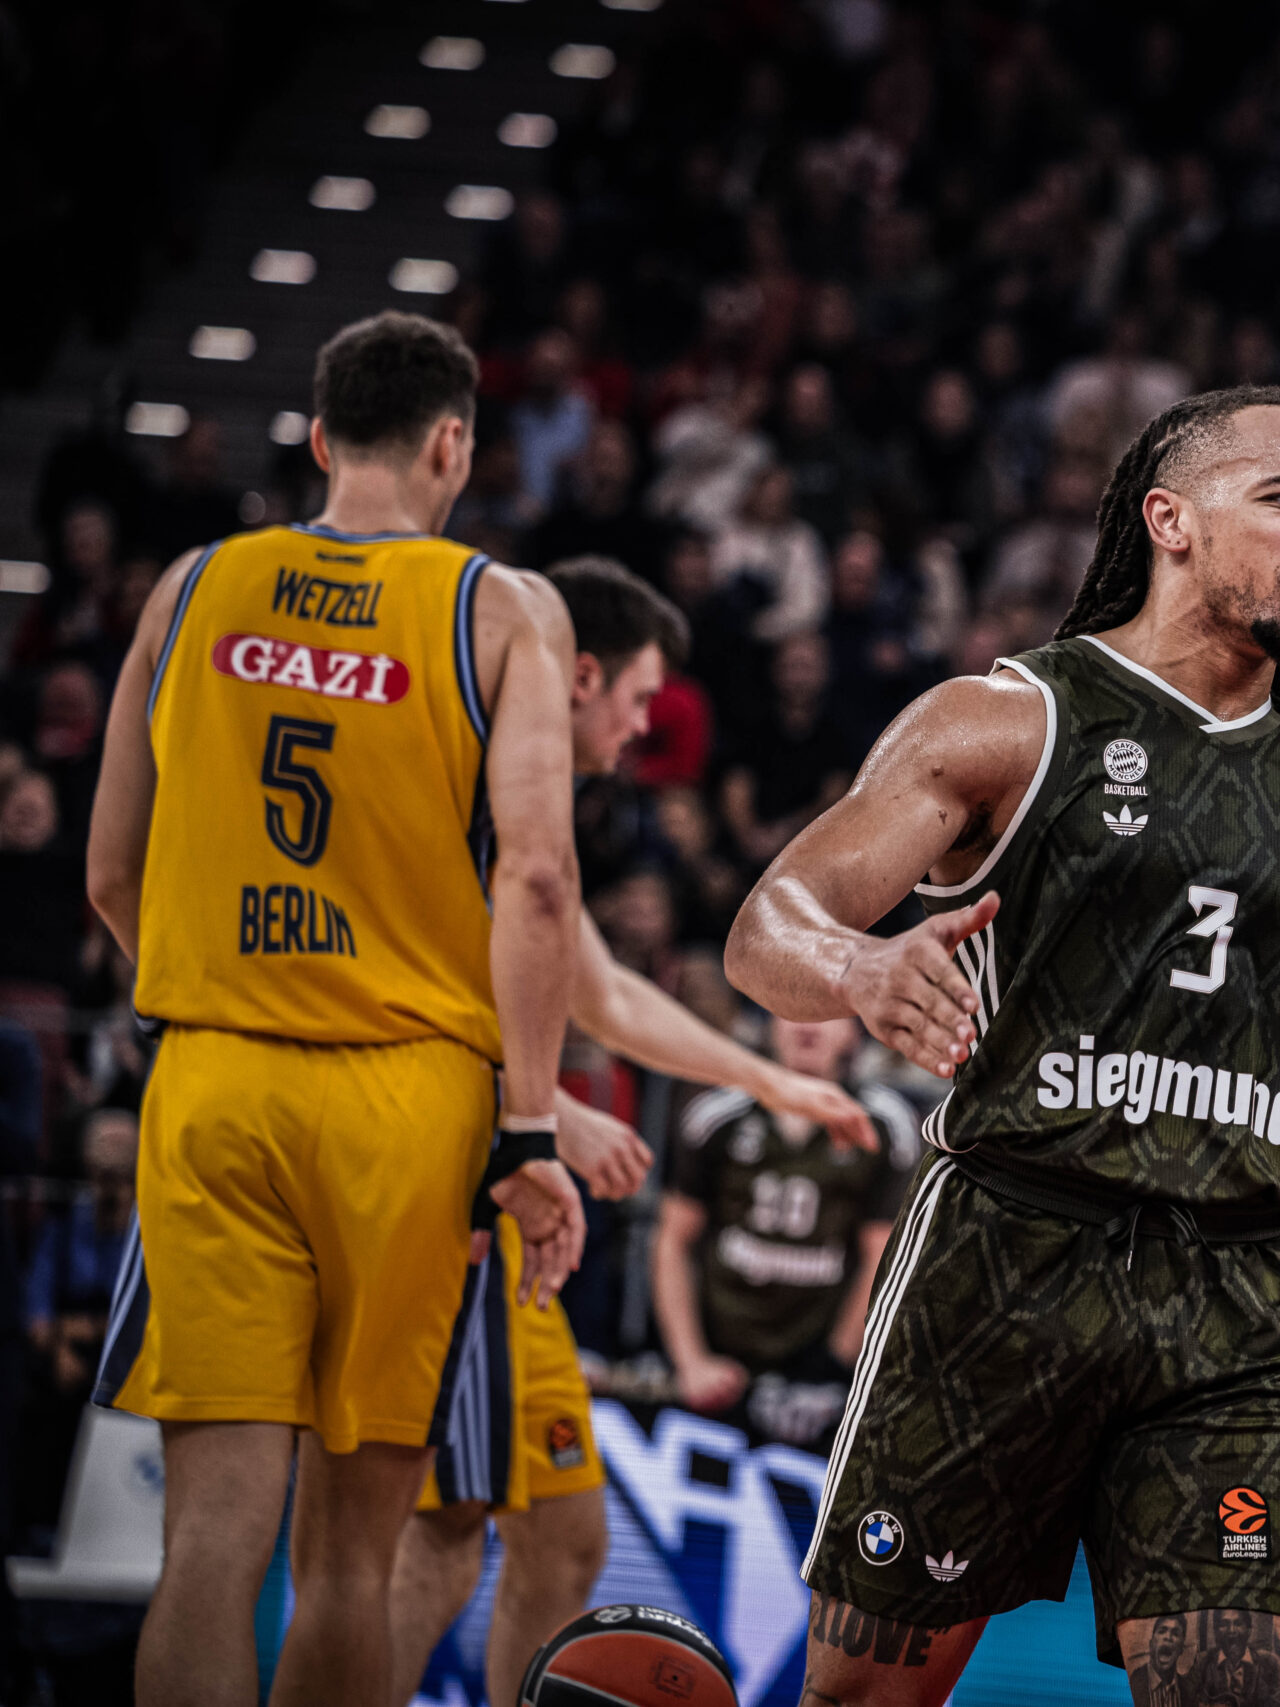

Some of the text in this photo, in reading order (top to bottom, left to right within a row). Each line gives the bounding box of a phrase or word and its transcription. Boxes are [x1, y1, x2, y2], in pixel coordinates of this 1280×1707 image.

[272, 566, 383, 628] WETZELL
[1107, 743, 1143, 758] FC BAYERN
[261, 713, 337, 869] 5
[1104, 783, 1149, 796] BASKETBALL
[239, 883, 358, 958] BERLIN
[1170, 886, 1239, 994] 3
[866, 1514, 901, 1534] BMW
[1222, 1535, 1267, 1544] TURKISH
[1223, 1543, 1267, 1551] AIRLINES
[1222, 1551, 1267, 1559] EuroLeague
